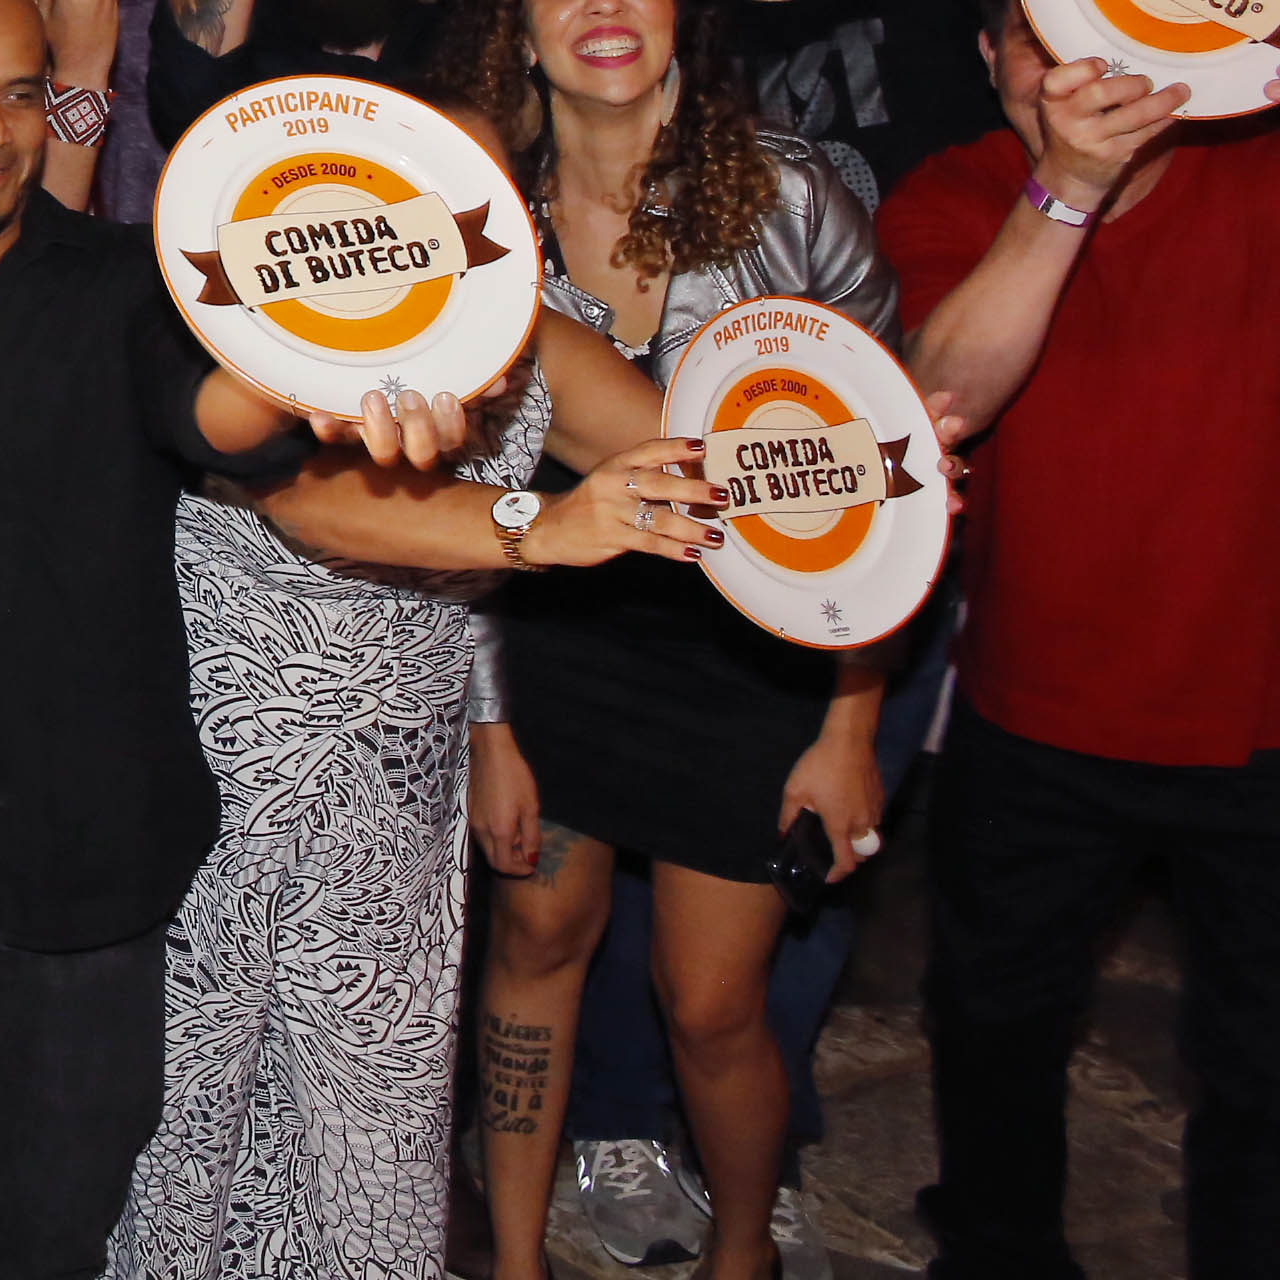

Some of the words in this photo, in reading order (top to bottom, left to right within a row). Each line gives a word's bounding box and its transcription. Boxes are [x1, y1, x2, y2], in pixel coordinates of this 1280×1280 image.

[225, 91, 379, 133] PARTICIPANTE
[282, 118, 330, 138] 2019
[271, 163, 317, 189] DESDE
[321, 163, 357, 178] 2000
[264, 215, 398, 258] COMIDA
[254, 261, 300, 294] DI
[713, 311, 830, 351] PARTICIPANTE
[754, 336, 789, 356] 2019
[743, 379, 779, 402] DESDE
[780, 379, 808, 396] 2000
[736, 437, 835, 472] COMIDA
[728, 476, 762, 508] DI
